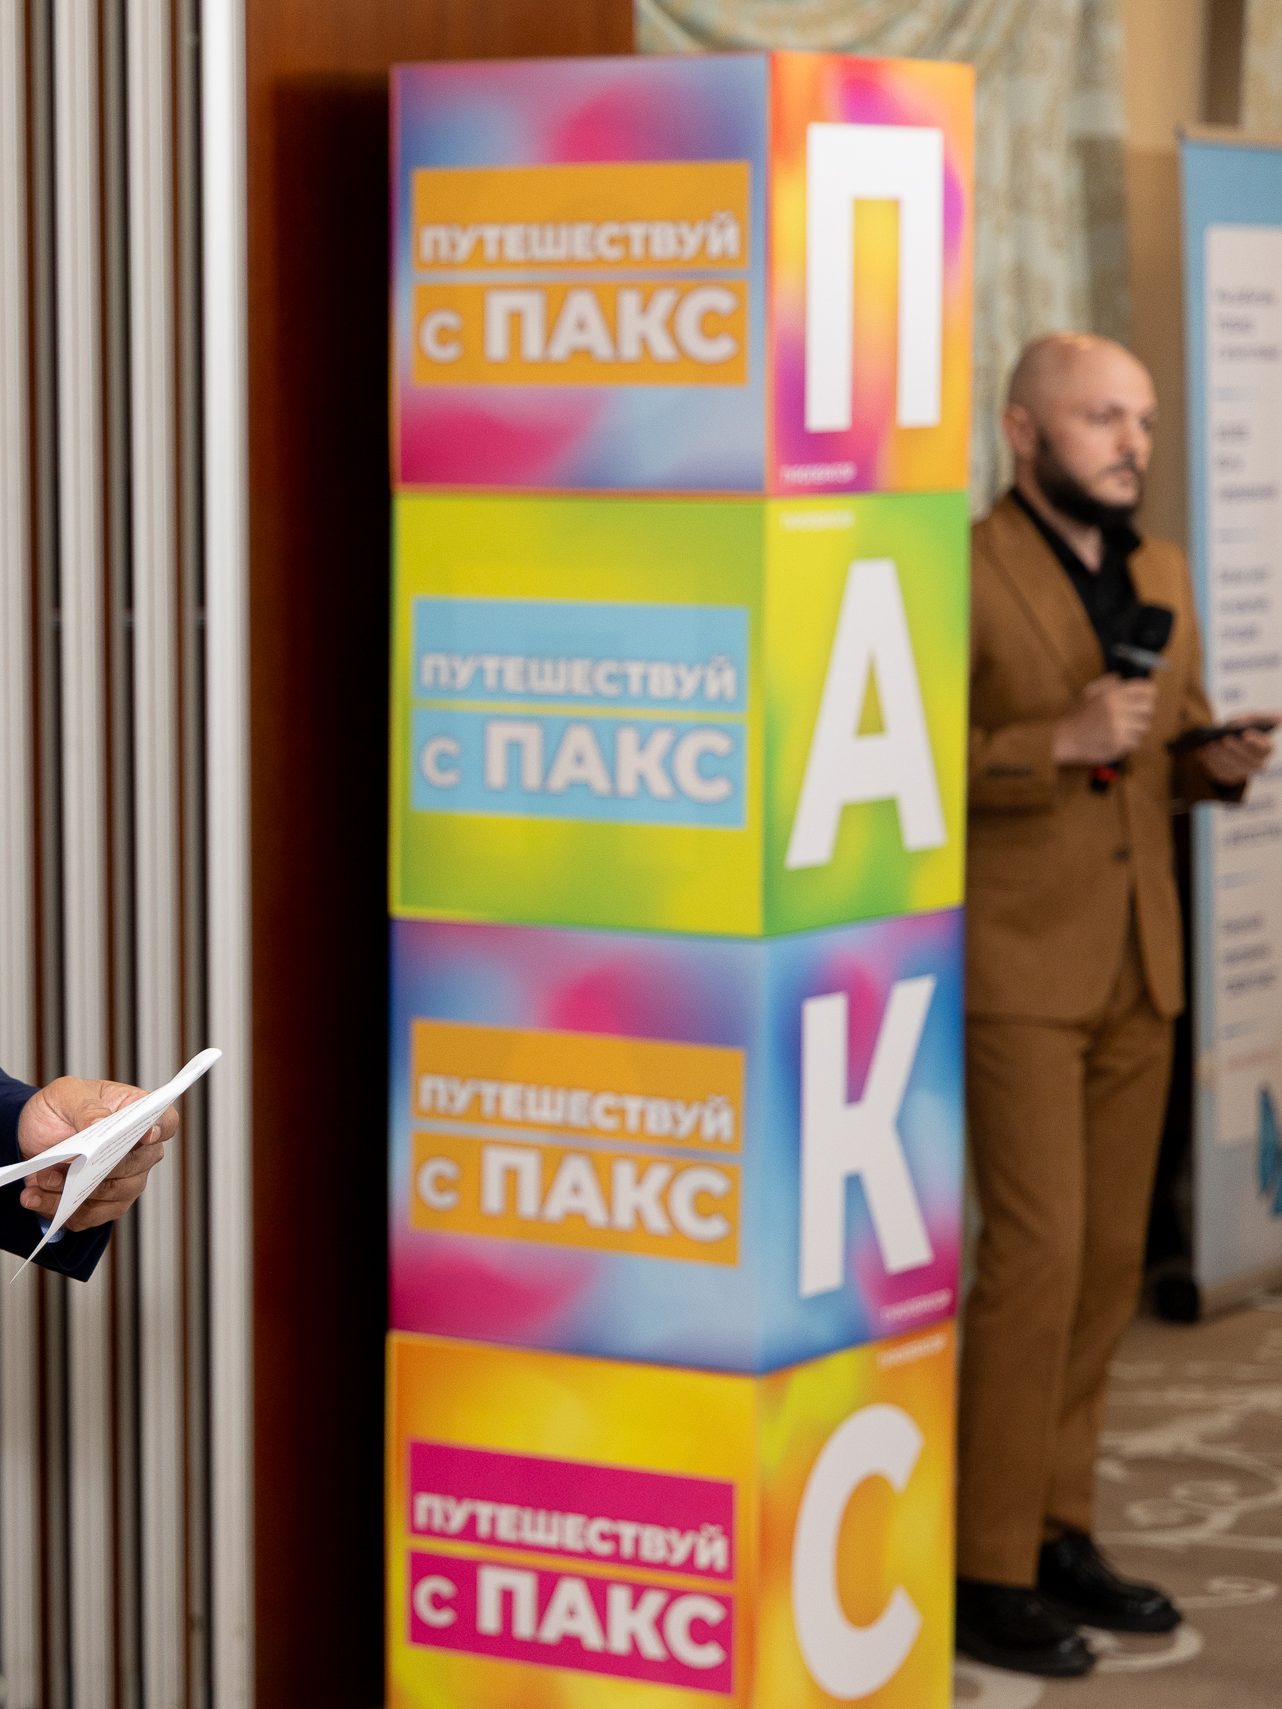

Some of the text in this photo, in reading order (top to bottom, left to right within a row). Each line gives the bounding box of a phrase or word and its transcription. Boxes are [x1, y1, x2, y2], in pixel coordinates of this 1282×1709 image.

[423, 212, 738, 262] ПУТЕШЕСТВУЙ
[807, 124, 942, 430] П
[485, 288, 737, 362] ПАКС
[423, 654, 735, 701] ПУТЕШЕСТВУЙ
[787, 559, 946, 868] А
[485, 722, 731, 801] ПАКС
[422, 1075, 732, 1141] ПУТЕШЕСТВУЙ
[802, 975, 934, 1297] К
[483, 1147, 729, 1241] ПАКС
[416, 1494, 727, 1570] ПУТЕШЕСТВУЙ
[794, 1404, 923, 1698] С
[478, 1566, 725, 1668] ПАКС
